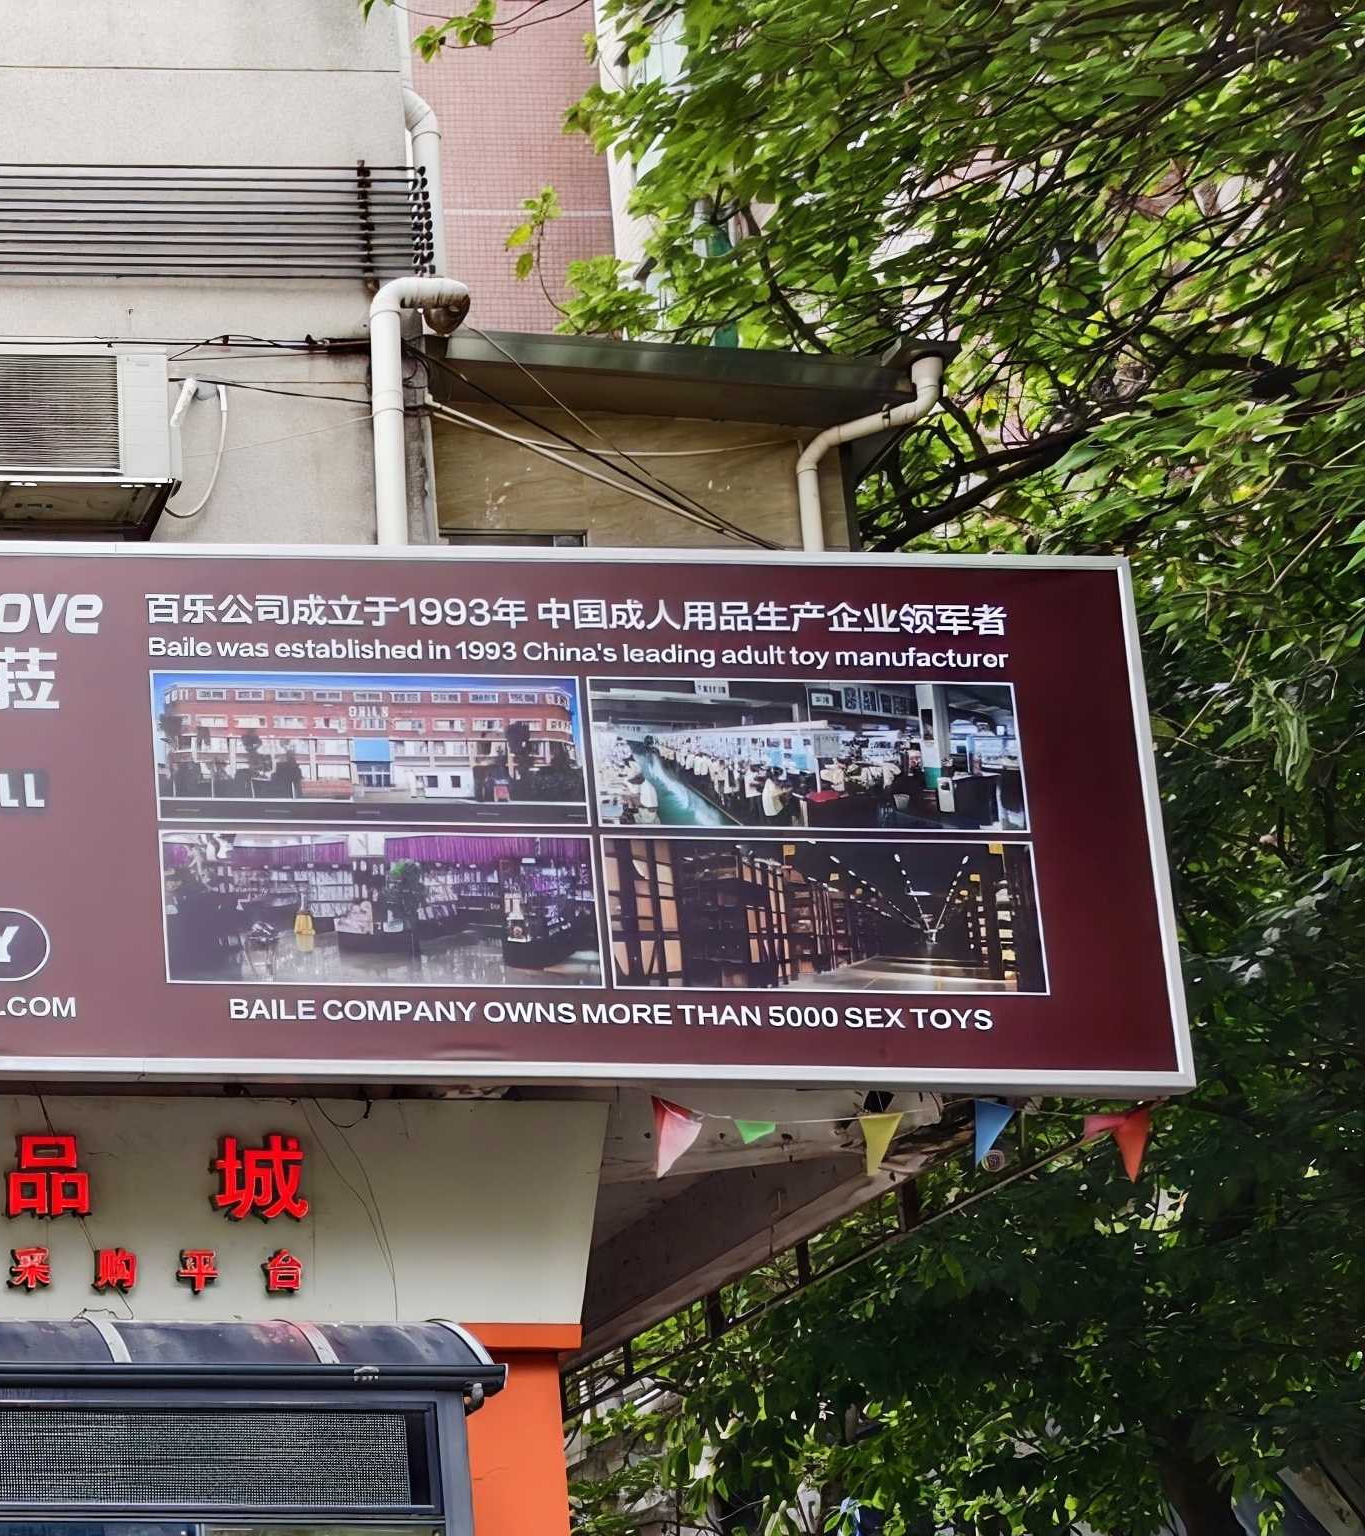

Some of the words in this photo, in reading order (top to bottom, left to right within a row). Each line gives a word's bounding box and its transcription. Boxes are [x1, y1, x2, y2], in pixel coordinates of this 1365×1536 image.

[148, 636, 212, 658] Baile
[216, 641, 269, 658] was
[274, 637, 423, 660] established
[428, 641, 451, 660] in
[455, 640, 518, 661] 1993
[523, 640, 618, 663] China's
[622, 643, 716, 668] leading
[721, 645, 786, 667] adult
[789, 646, 830, 670] toy
[834, 646, 1009, 669] manufacturer
[229, 998, 317, 1020] BAILE
[322, 999, 477, 1022] COMPANY
[483, 1001, 577, 1023] OWNS
[582, 1002, 672, 1025] MORE
[677, 1003, 762, 1026] THAN
[768, 1005, 839, 1028] 5000
[844, 1007, 907, 1029] SEX
[909, 1008, 994, 1030] TOYS
